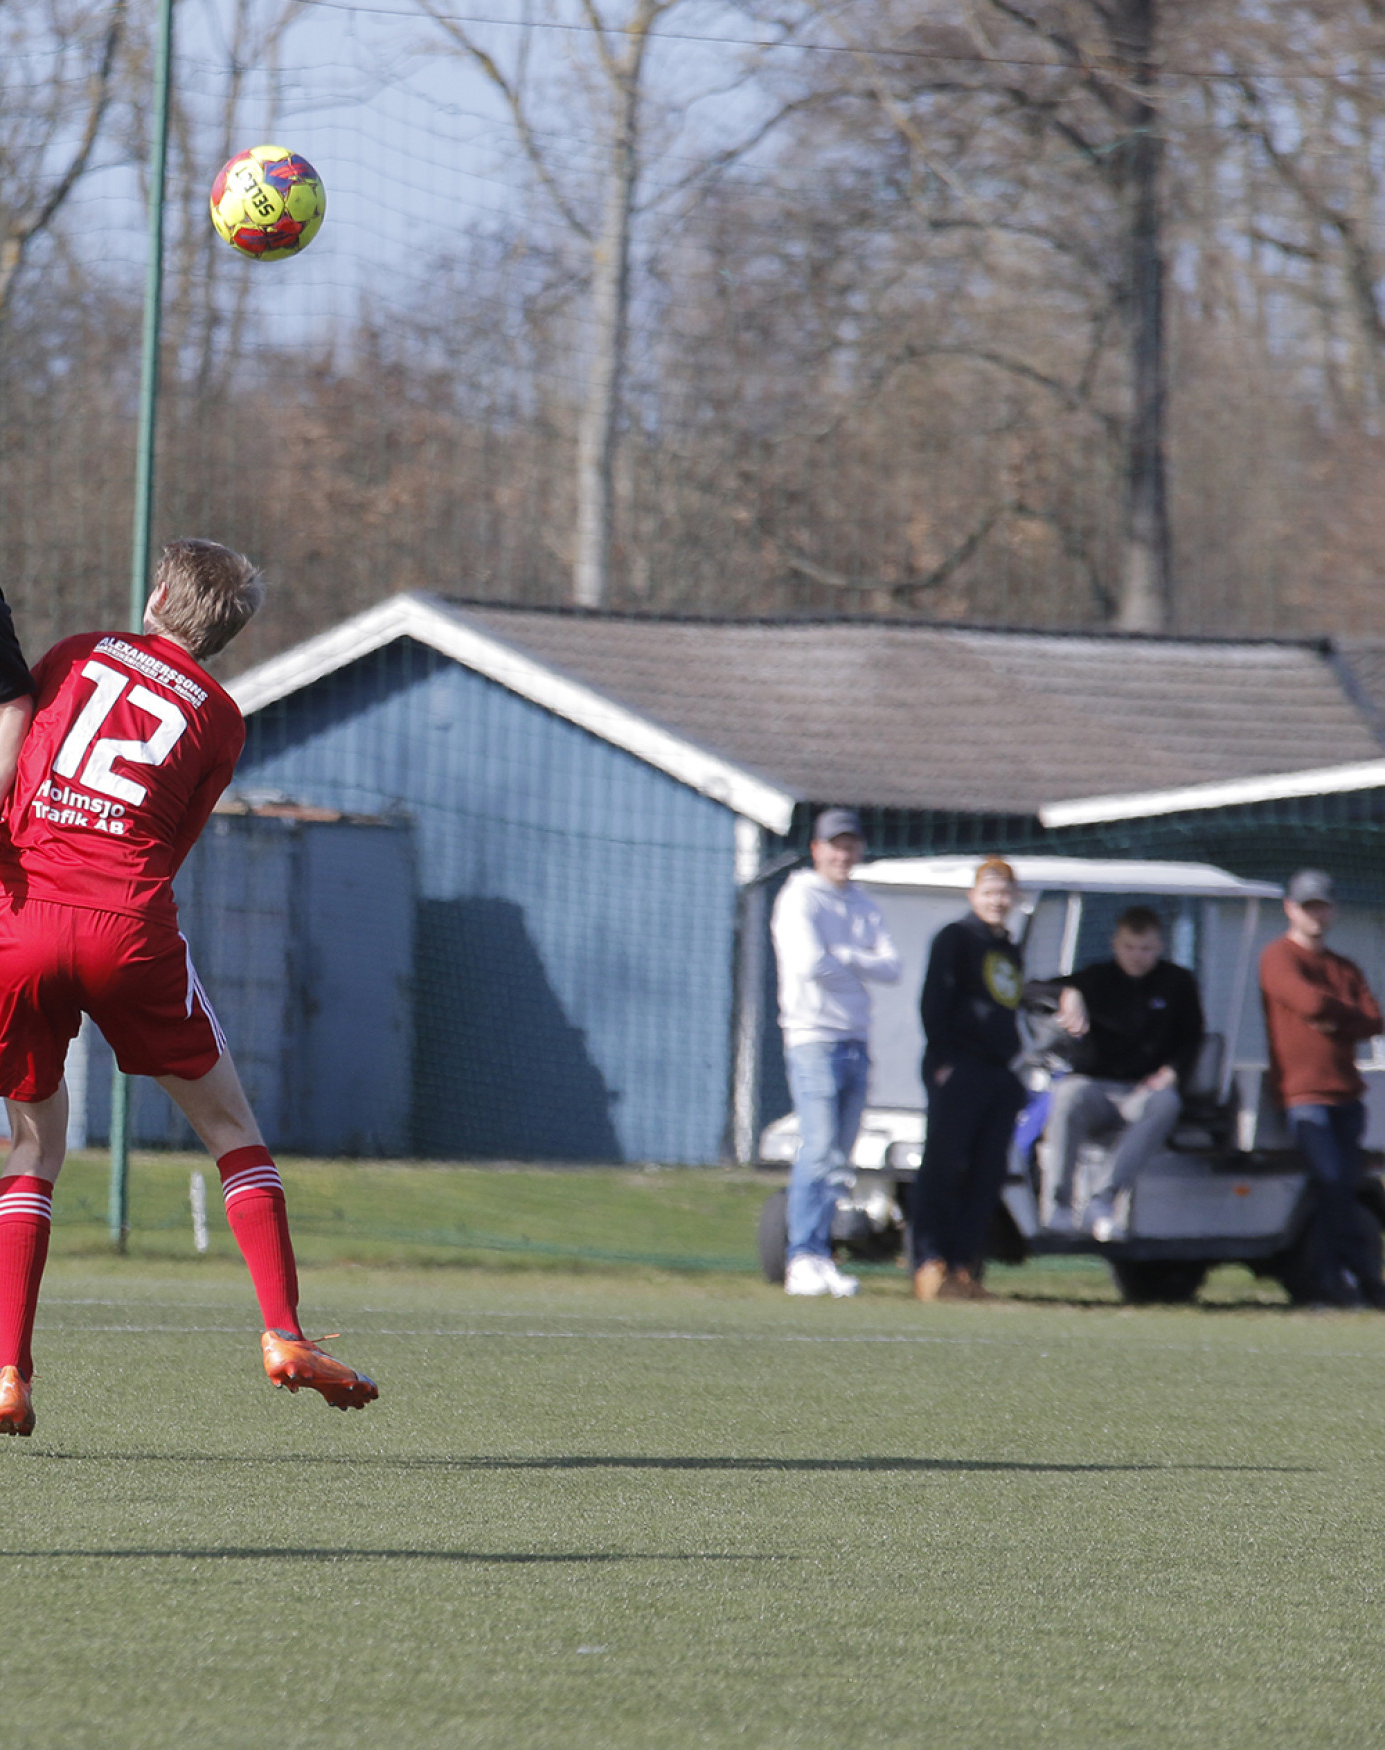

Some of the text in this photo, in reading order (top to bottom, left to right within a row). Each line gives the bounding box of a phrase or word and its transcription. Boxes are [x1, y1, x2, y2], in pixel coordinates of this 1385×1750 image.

[96, 636, 209, 702] ALEXANDERSSONS
[53, 659, 188, 807] 12
[31, 800, 125, 835] Trafik AB
